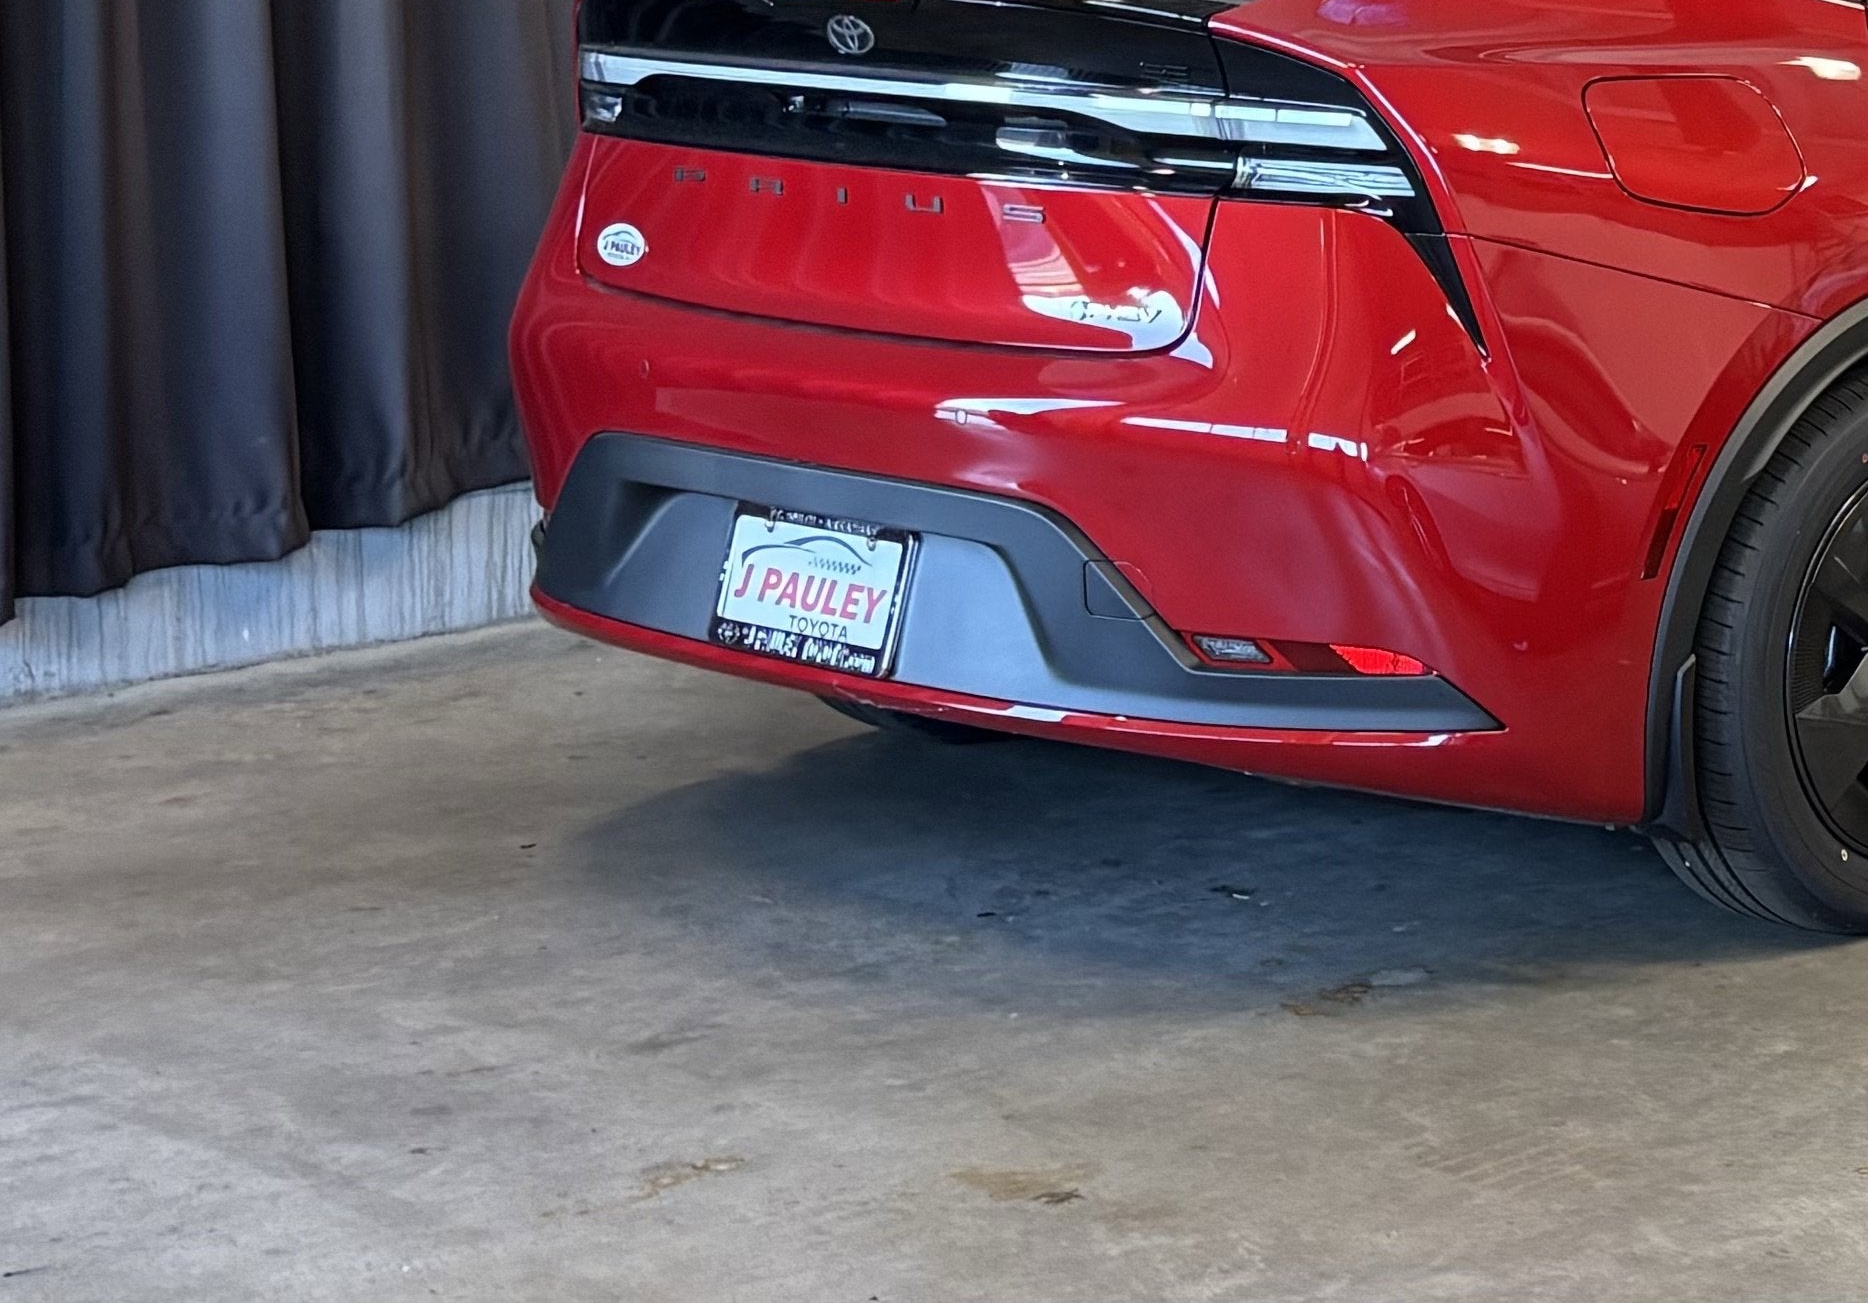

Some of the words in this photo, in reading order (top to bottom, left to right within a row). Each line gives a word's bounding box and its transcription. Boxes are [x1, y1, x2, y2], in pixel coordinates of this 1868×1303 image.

[674, 167, 1045, 224] PRIUS
[611, 240, 641, 256] PAULEY
[733, 563, 755, 599] J
[758, 567, 887, 624] PAULEY
[789, 614, 848, 640] TOYOTA
